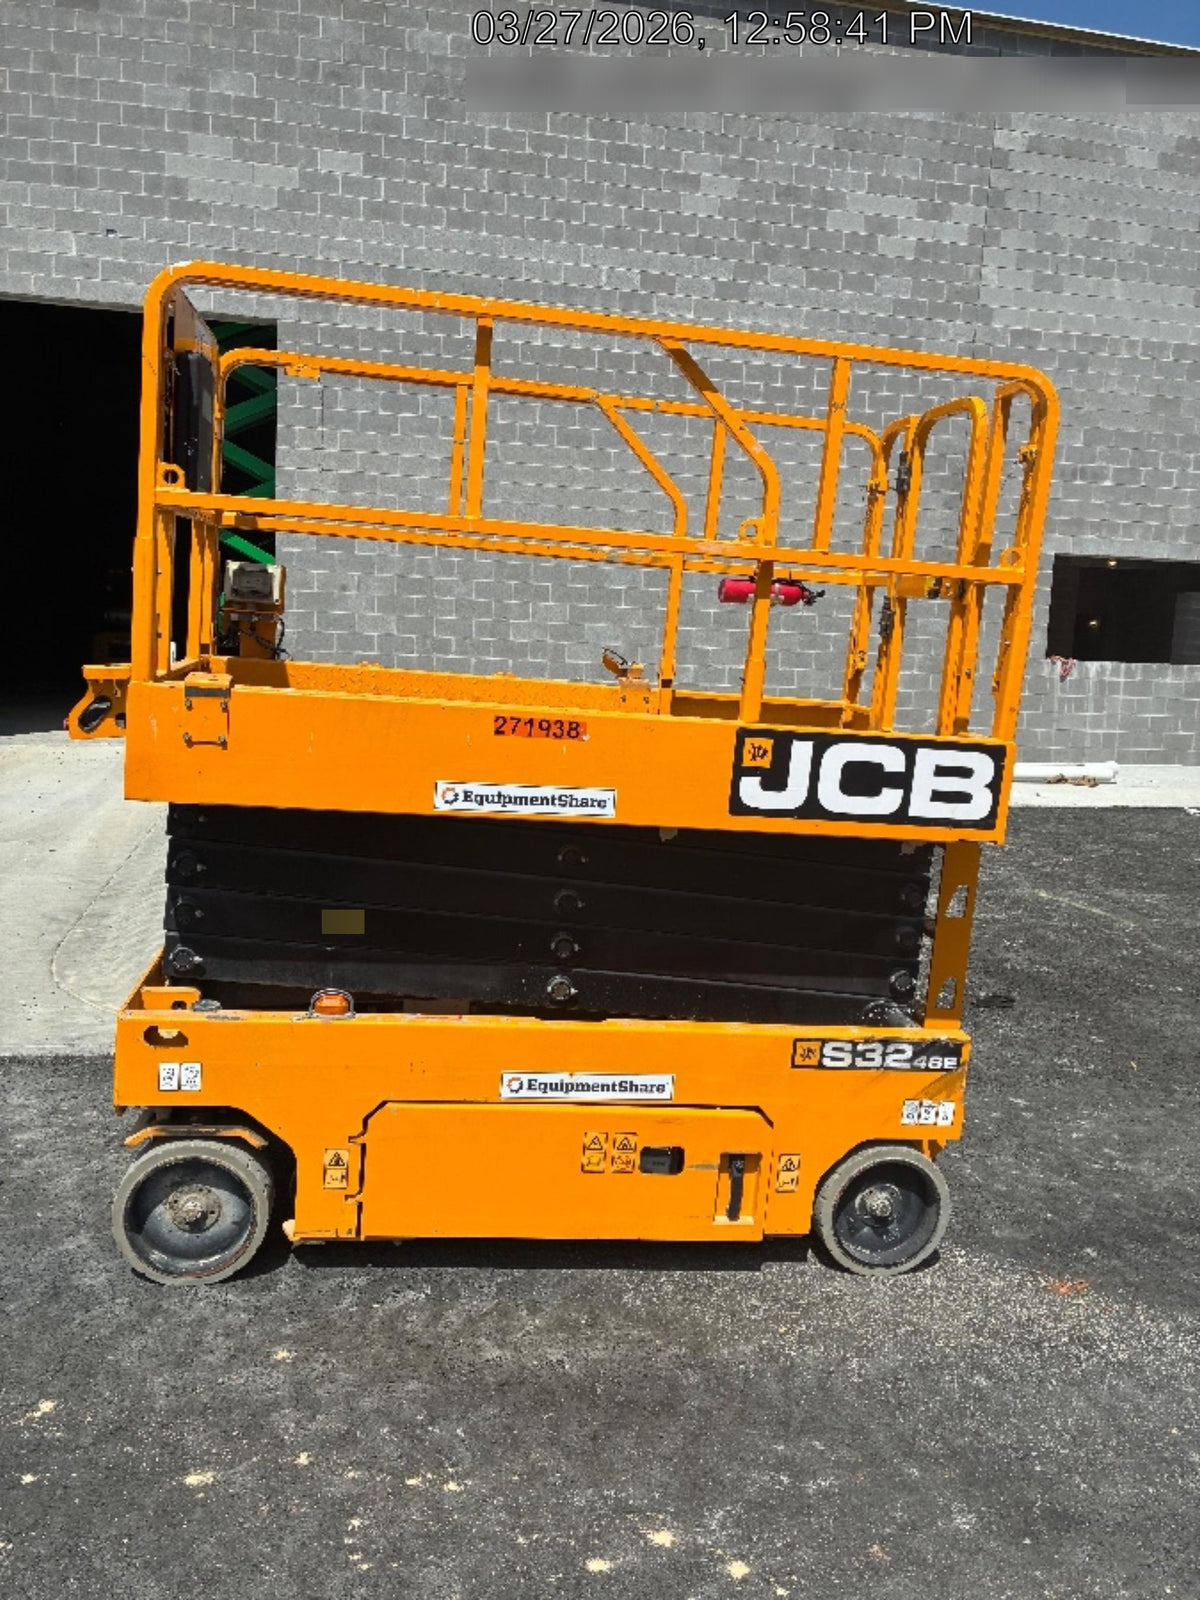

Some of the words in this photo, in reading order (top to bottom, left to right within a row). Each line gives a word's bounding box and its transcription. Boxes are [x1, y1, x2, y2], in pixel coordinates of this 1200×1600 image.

[494, 716, 581, 739] 271938
[739, 739, 995, 820] JCB
[461, 789, 608, 809] EquipmentShare
[526, 1078, 667, 1094] EquipmentShare
